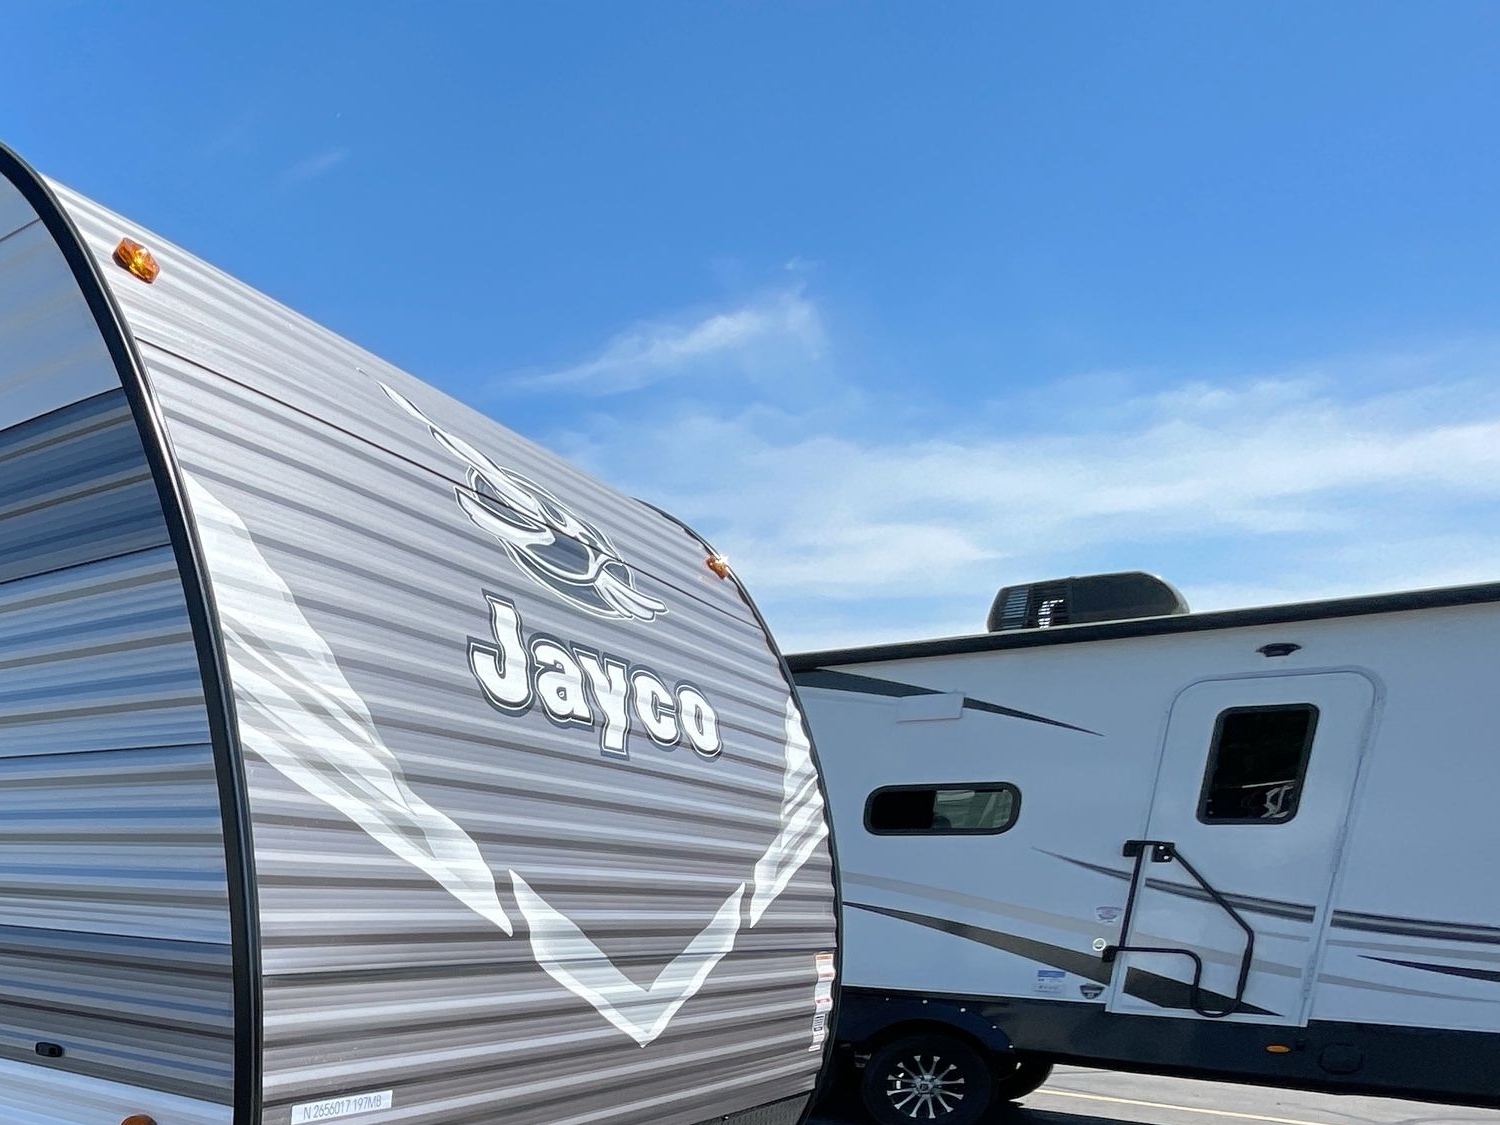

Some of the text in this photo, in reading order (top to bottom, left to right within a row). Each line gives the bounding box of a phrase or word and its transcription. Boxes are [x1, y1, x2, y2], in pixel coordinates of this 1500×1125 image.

[467, 590, 723, 762] Jayco
[303, 1107, 311, 1120] N
[313, 1100, 351, 1119] 2656017
